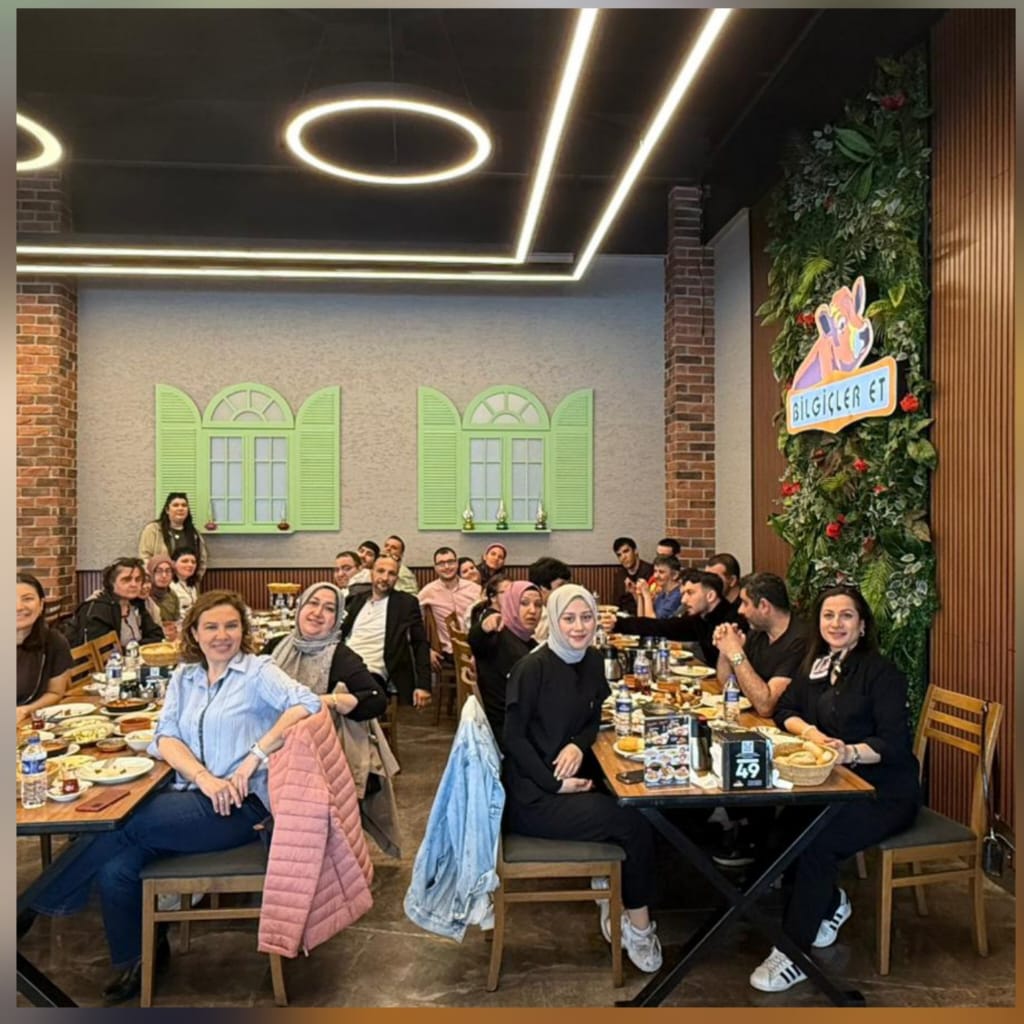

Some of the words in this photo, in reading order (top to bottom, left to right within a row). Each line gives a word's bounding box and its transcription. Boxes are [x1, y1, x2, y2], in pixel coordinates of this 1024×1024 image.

[792, 385, 860, 422] BİLGİÇLER
[869, 377, 886, 403] ET
[736, 762, 760, 778] 49
